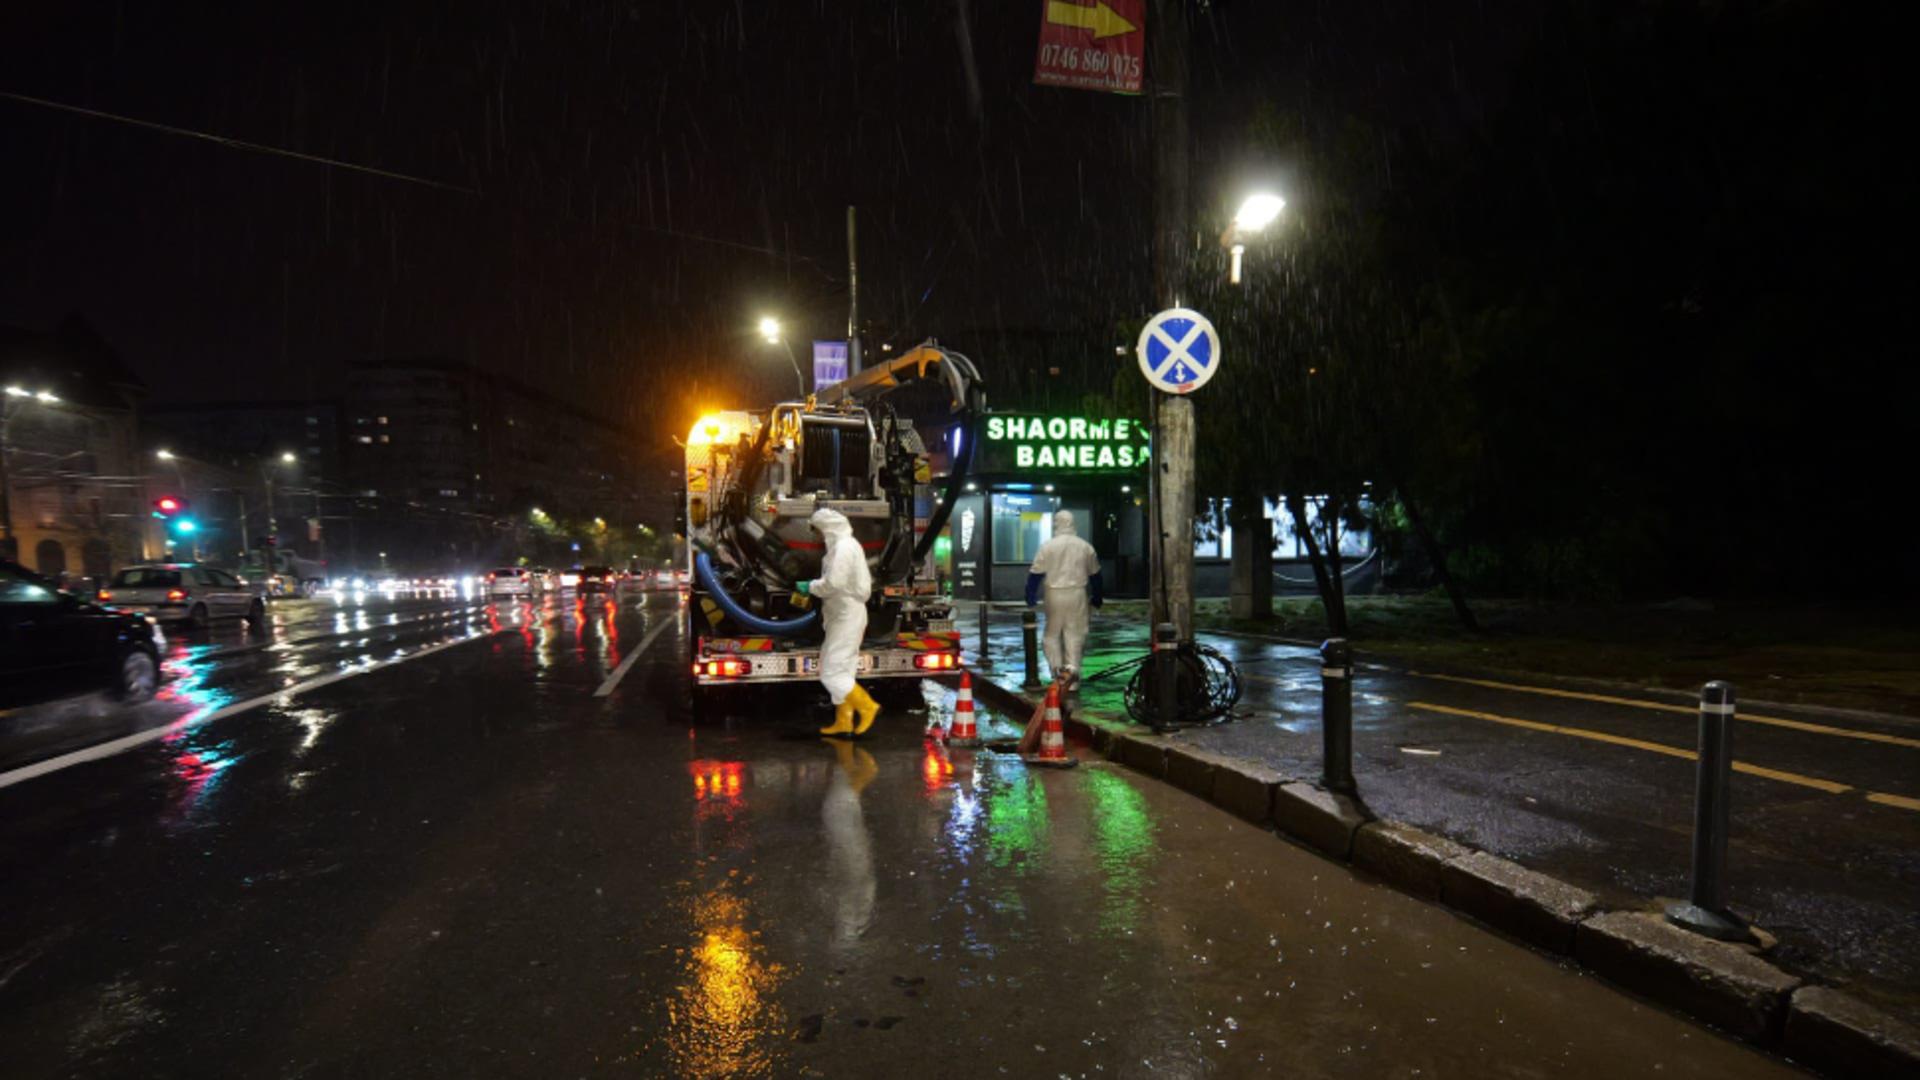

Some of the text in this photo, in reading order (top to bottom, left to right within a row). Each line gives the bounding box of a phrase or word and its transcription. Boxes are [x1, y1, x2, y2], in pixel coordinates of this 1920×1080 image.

[1041, 45, 1140, 77] 0746 860 075
